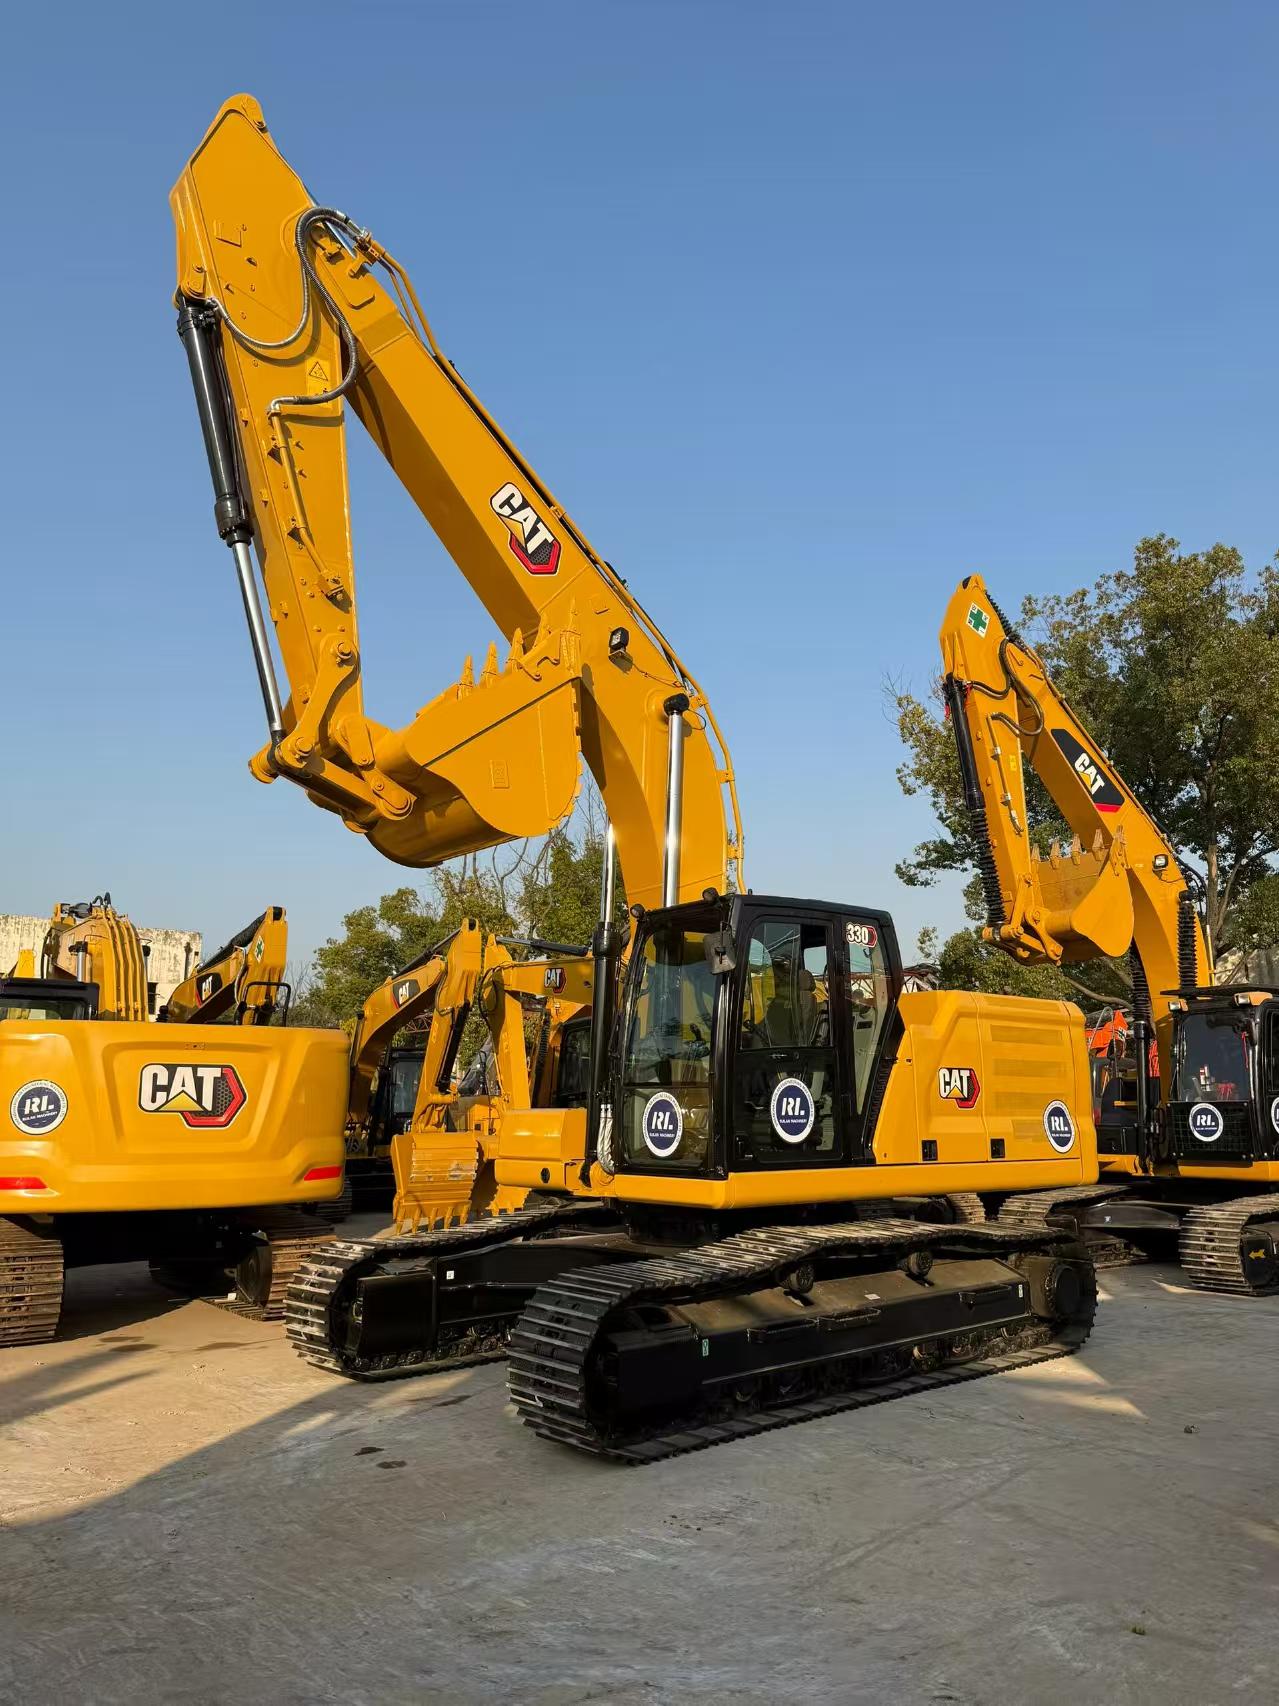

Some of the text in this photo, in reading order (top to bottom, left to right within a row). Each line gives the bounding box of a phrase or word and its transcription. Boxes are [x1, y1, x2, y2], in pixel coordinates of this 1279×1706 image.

[491, 482, 555, 554] CAT
[1074, 752, 1105, 794] CAT
[846, 923, 869, 944] 330
[202, 975, 213, 1000] CAT
[544, 968, 562, 988] CAT
[399, 981, 409, 1004] CAT
[141, 1064, 222, 1111] CAT
[939, 1068, 970, 1098] CAT
